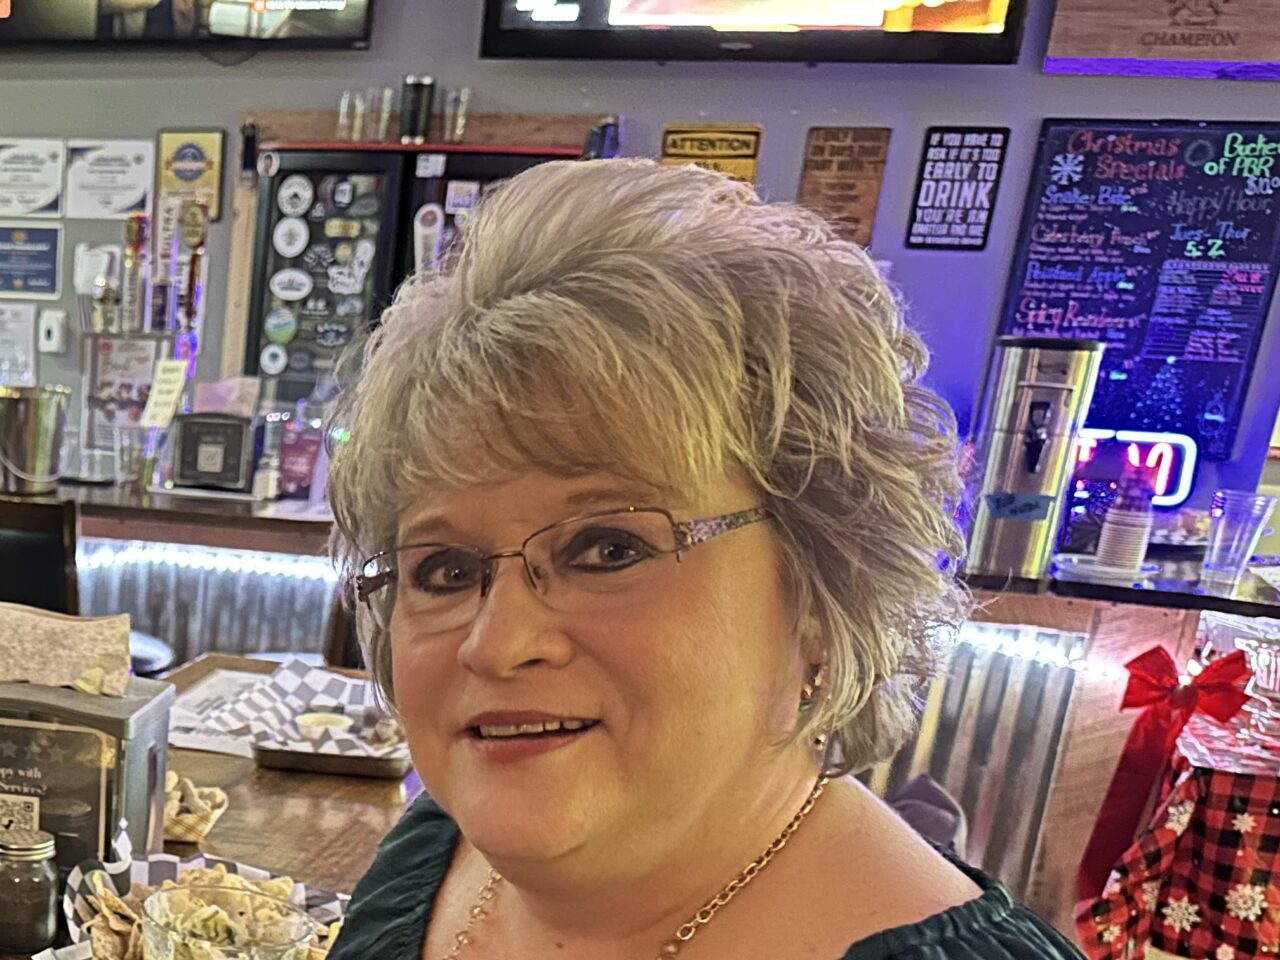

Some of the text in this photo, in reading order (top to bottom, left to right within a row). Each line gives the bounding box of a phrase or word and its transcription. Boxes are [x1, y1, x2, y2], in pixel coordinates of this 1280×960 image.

[1138, 31, 1240, 47] CHAMPION
[669, 137, 752, 151] ATTENTION
[1067, 129, 1182, 156] Christmas
[923, 161, 999, 180] EARLY TO
[1094, 154, 1185, 181] Specials
[1231, 156, 1276, 178] PBR
[917, 180, 994, 209] DRINK
[17, 765, 42, 779] with
